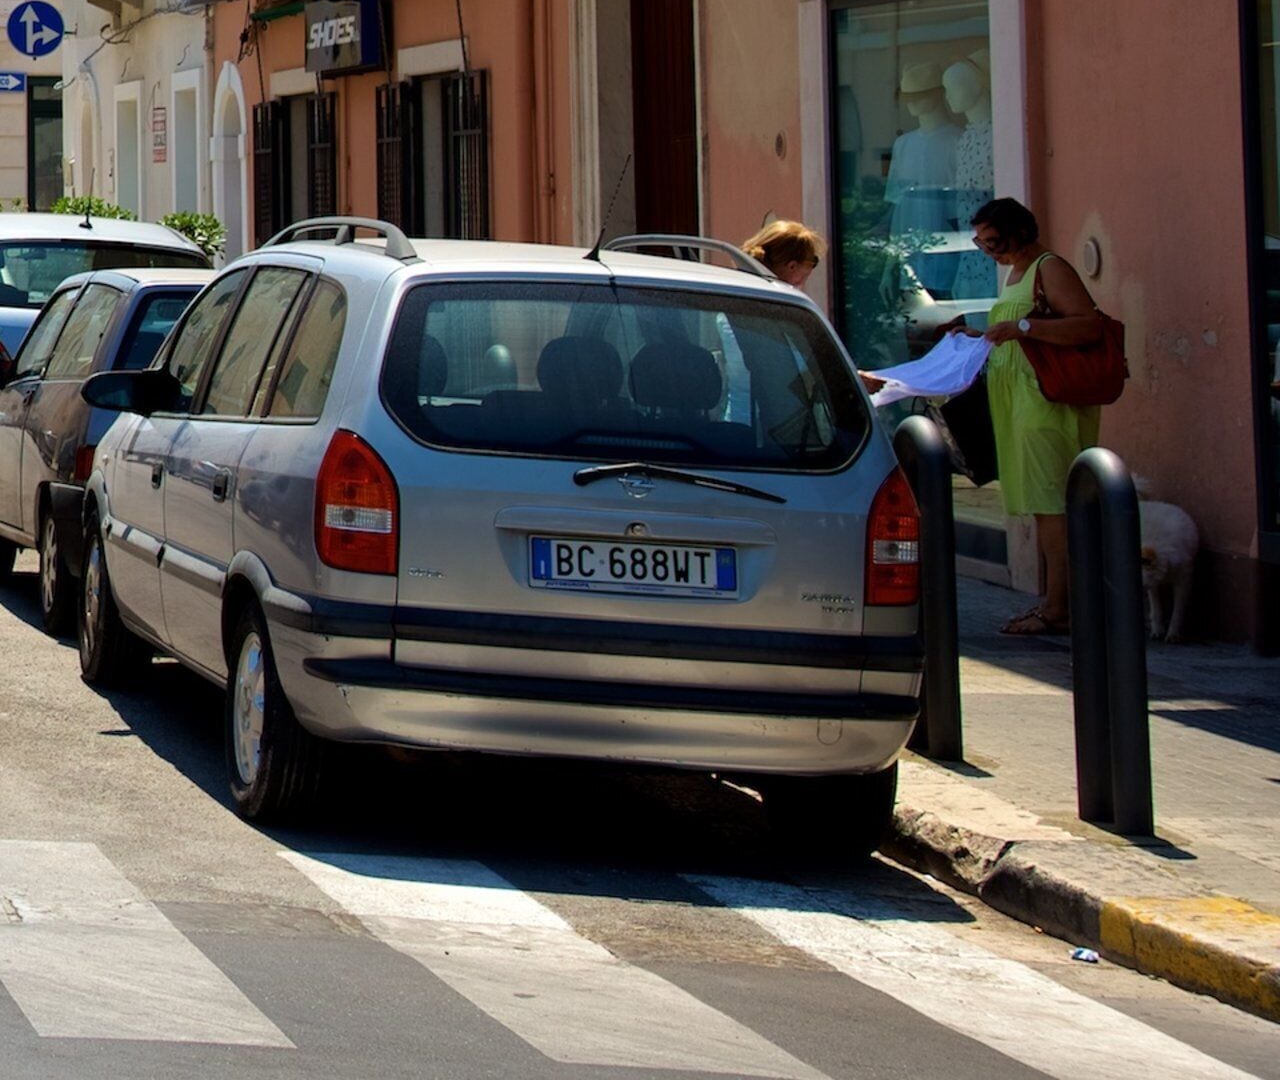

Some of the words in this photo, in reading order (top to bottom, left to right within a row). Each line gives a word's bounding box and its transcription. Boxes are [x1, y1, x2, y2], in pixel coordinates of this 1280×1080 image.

[307, 16, 355, 50] SHOES
[556, 544, 595, 578] BC
[608, 546, 711, 585] 688WT
